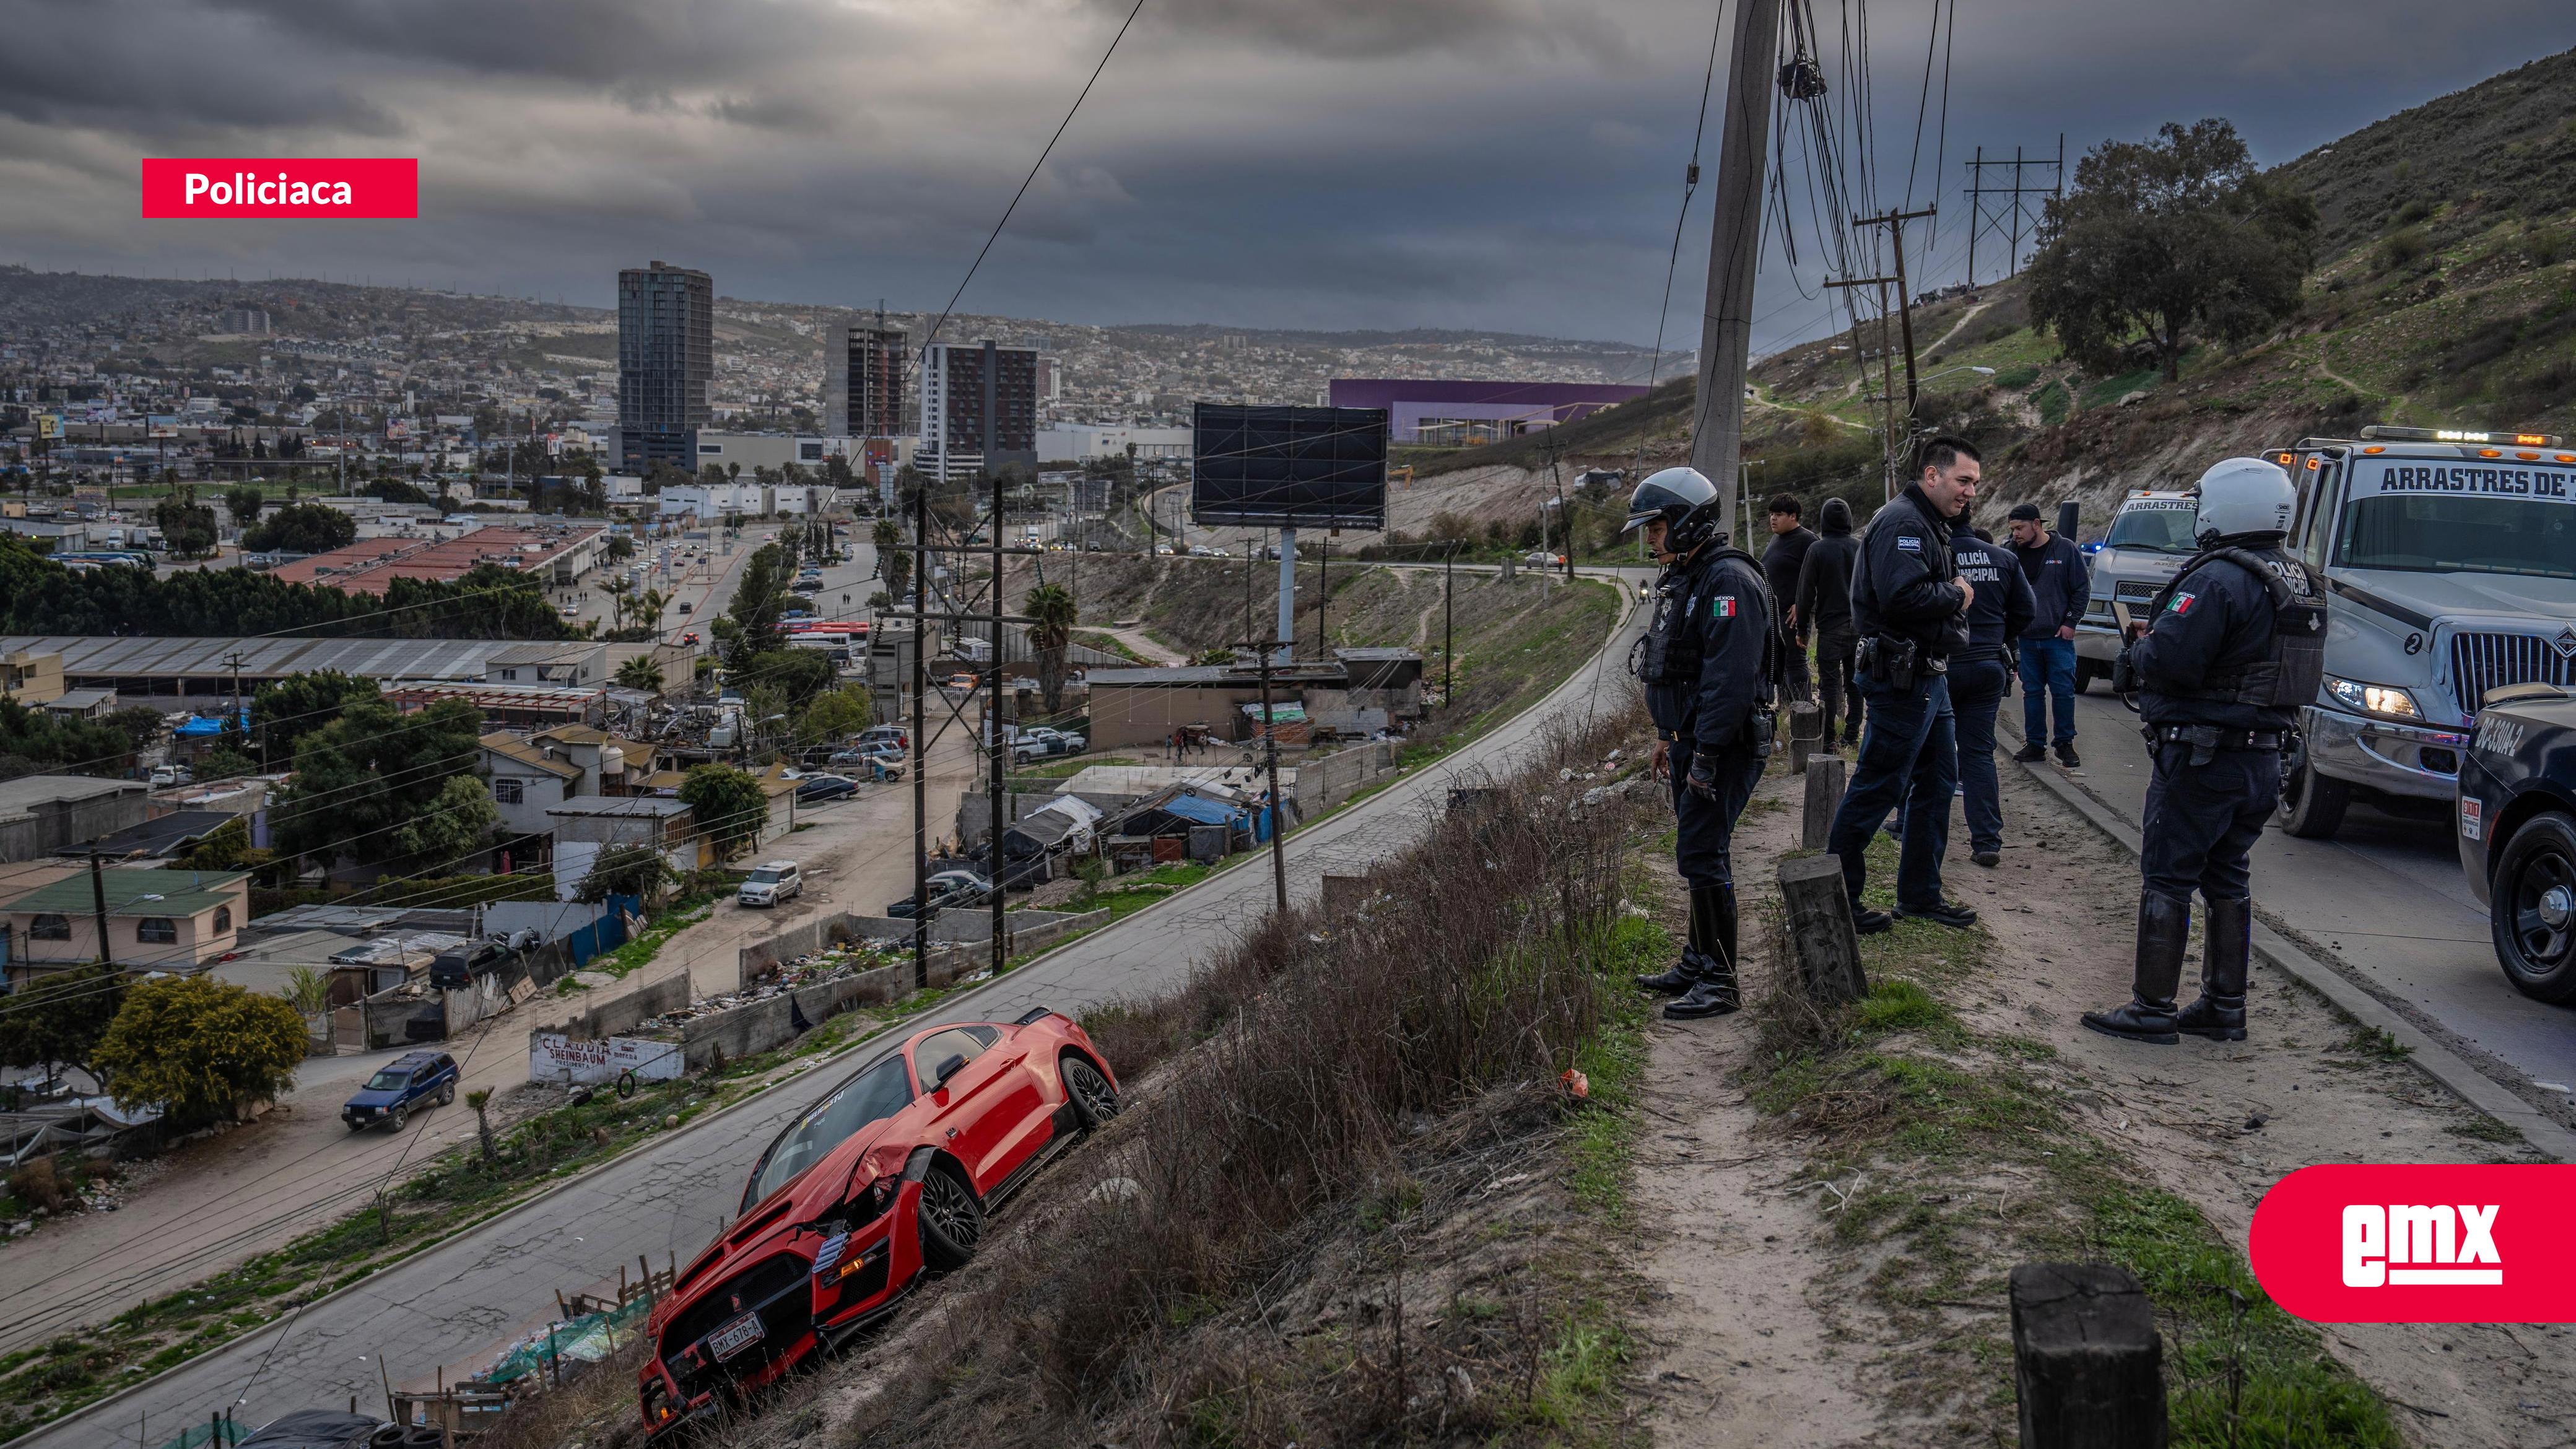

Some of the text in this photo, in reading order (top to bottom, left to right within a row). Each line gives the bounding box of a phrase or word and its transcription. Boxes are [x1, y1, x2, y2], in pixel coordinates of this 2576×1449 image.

[2380, 467, 2529, 494] ARRASTRES
[2533, 471, 2566, 497] DE
[2126, 501, 2199, 511] ARRASTRES
[1957, 549, 1991, 565] OLICÍA
[2406, 634, 2420, 653] 2
[2475, 717, 2524, 757] BC-330A-2
[2464, 802, 2478, 815] 911
[543, 1038, 611, 1056] CLAUDIA
[614, 1051, 638, 1060] morena
[549, 1048, 606, 1065] SHEINBAUM
[713, 1320, 760, 1354] BMX-678-A
